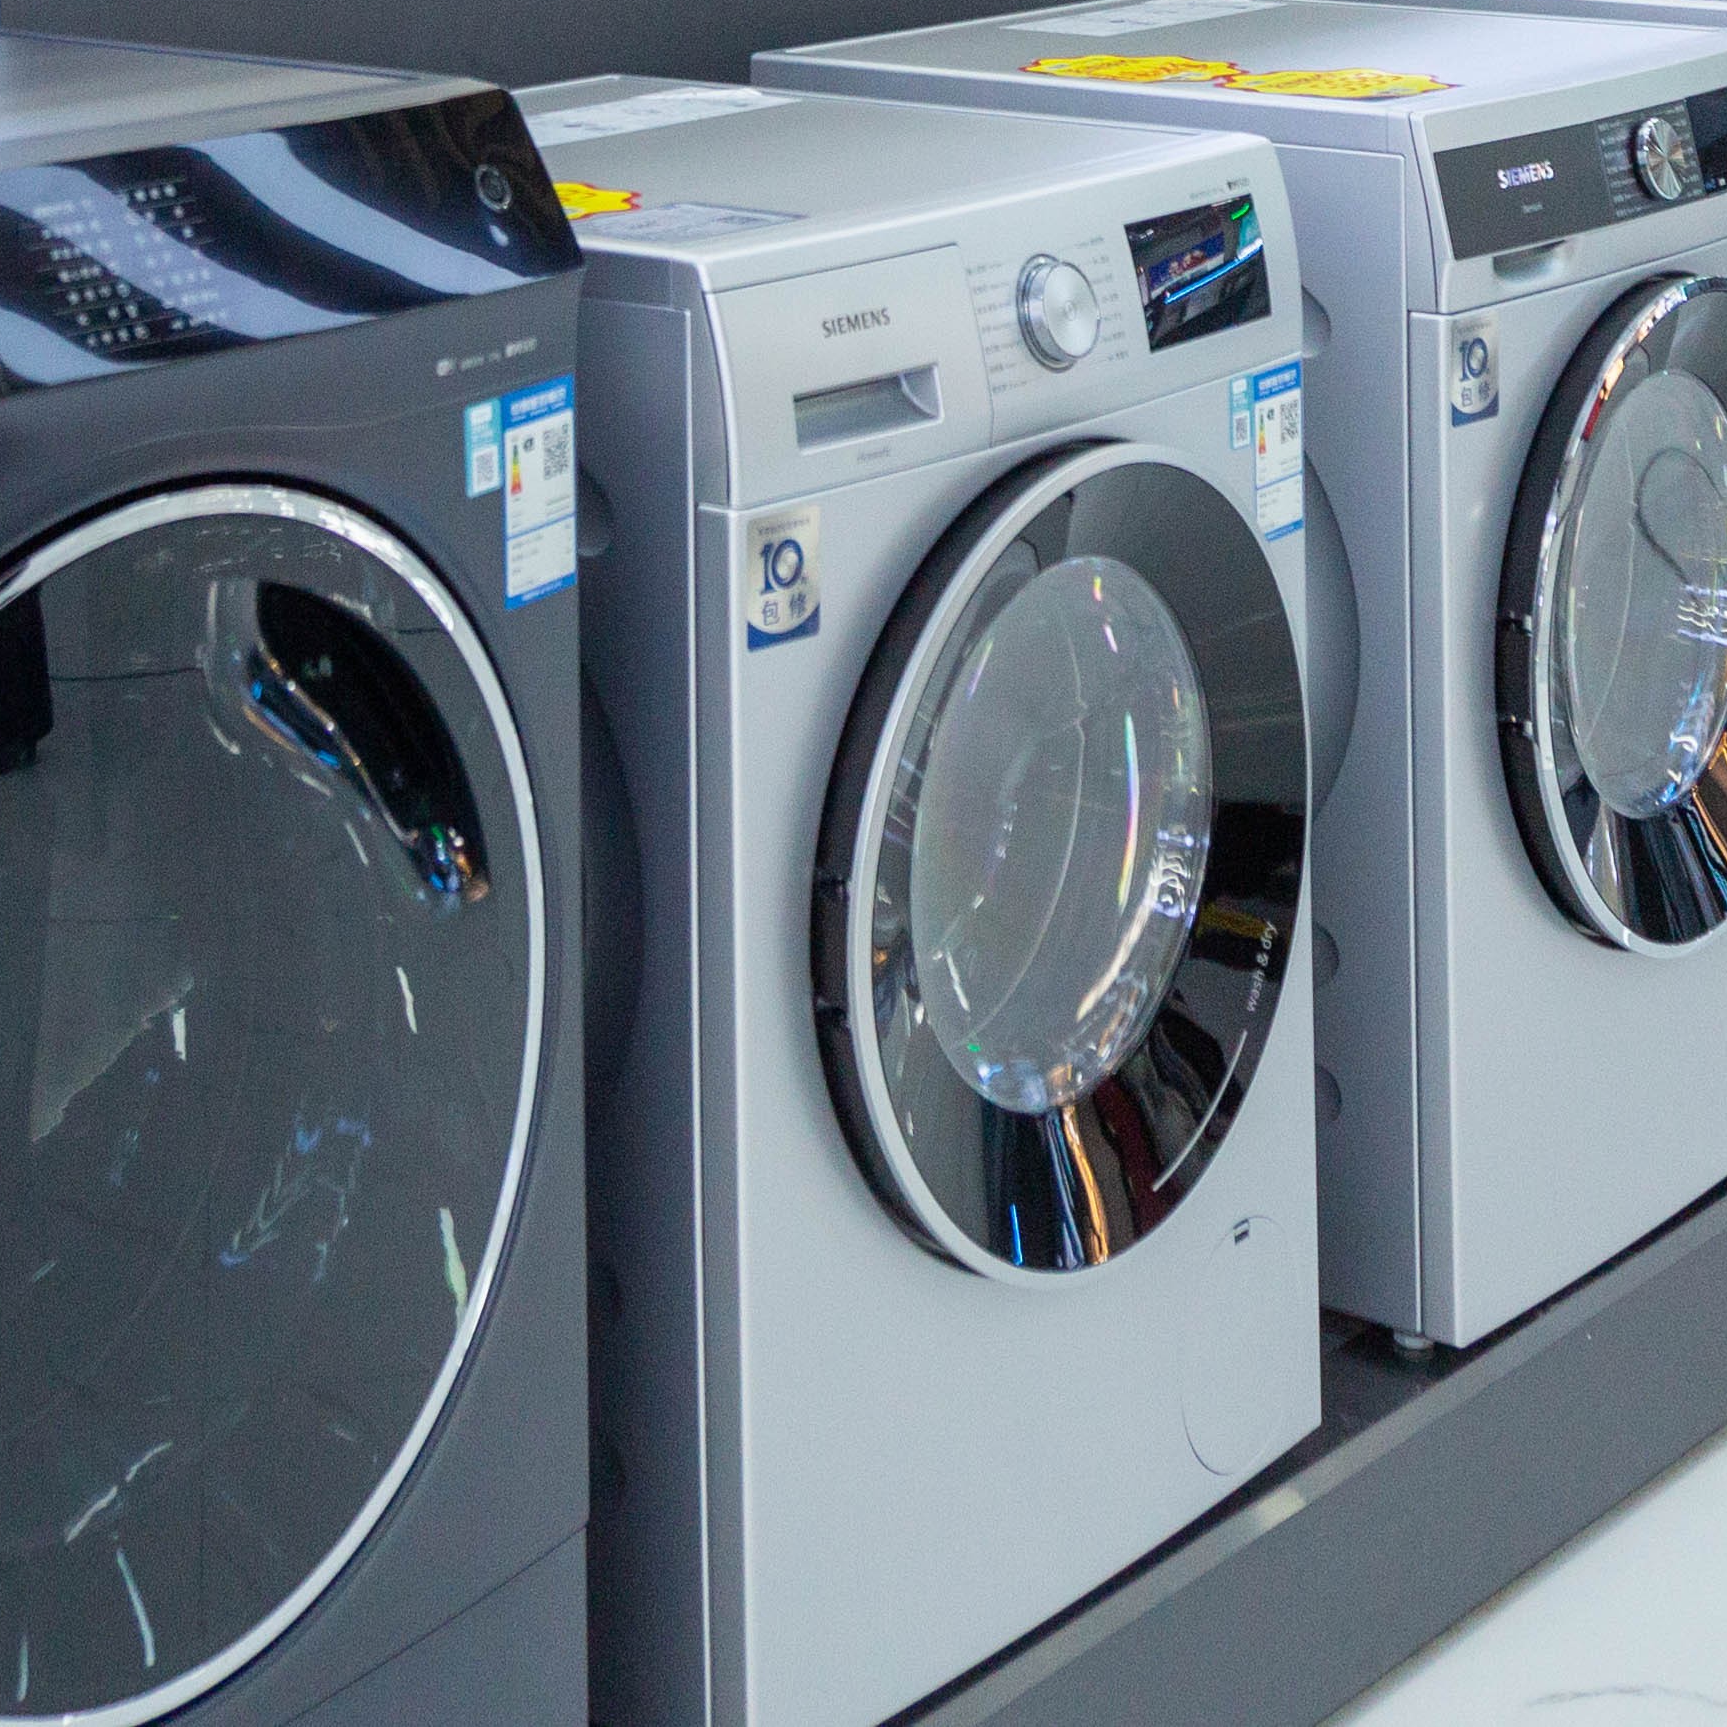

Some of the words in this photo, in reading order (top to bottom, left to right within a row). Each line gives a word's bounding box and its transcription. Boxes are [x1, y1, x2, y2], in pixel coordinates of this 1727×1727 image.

[1496, 159, 1555, 190] SIEMENS
[822, 306, 891, 339] SIEMENS
[1458, 336, 1489, 383] 10
[759, 538, 805, 595] 10
